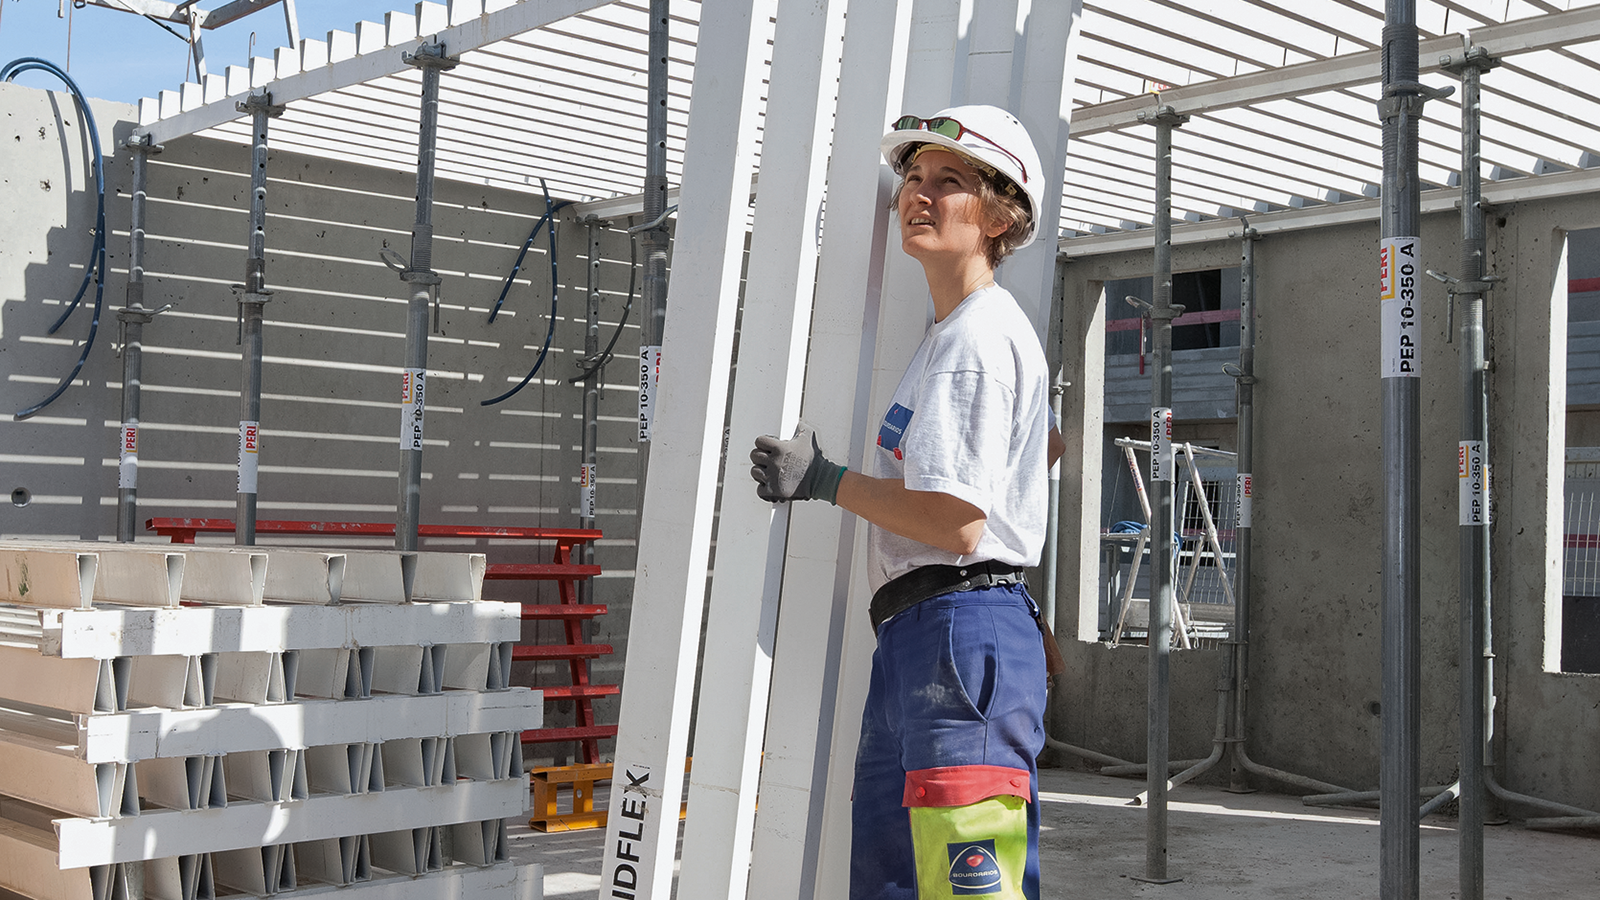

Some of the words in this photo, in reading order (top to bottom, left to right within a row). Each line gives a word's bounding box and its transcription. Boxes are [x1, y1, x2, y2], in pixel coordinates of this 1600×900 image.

[1400, 243, 1414, 258] A
[1400, 263, 1415, 330] 10-350
[641, 350, 649, 361] A
[1400, 334, 1414, 373] PEP
[416, 372, 424, 380] A
[640, 364, 649, 409] 10-350
[414, 384, 424, 423] 10-350
[1153, 410, 1160, 418] A
[126, 427, 136, 449] PERI
[245, 425, 256, 449] PERI
[413, 425, 422, 448] PEP
[640, 413, 648, 439] PEP
[1472, 444, 1480, 453] A
[1472, 456, 1481, 496] 10-350
[1472, 499, 1480, 523] PEP
